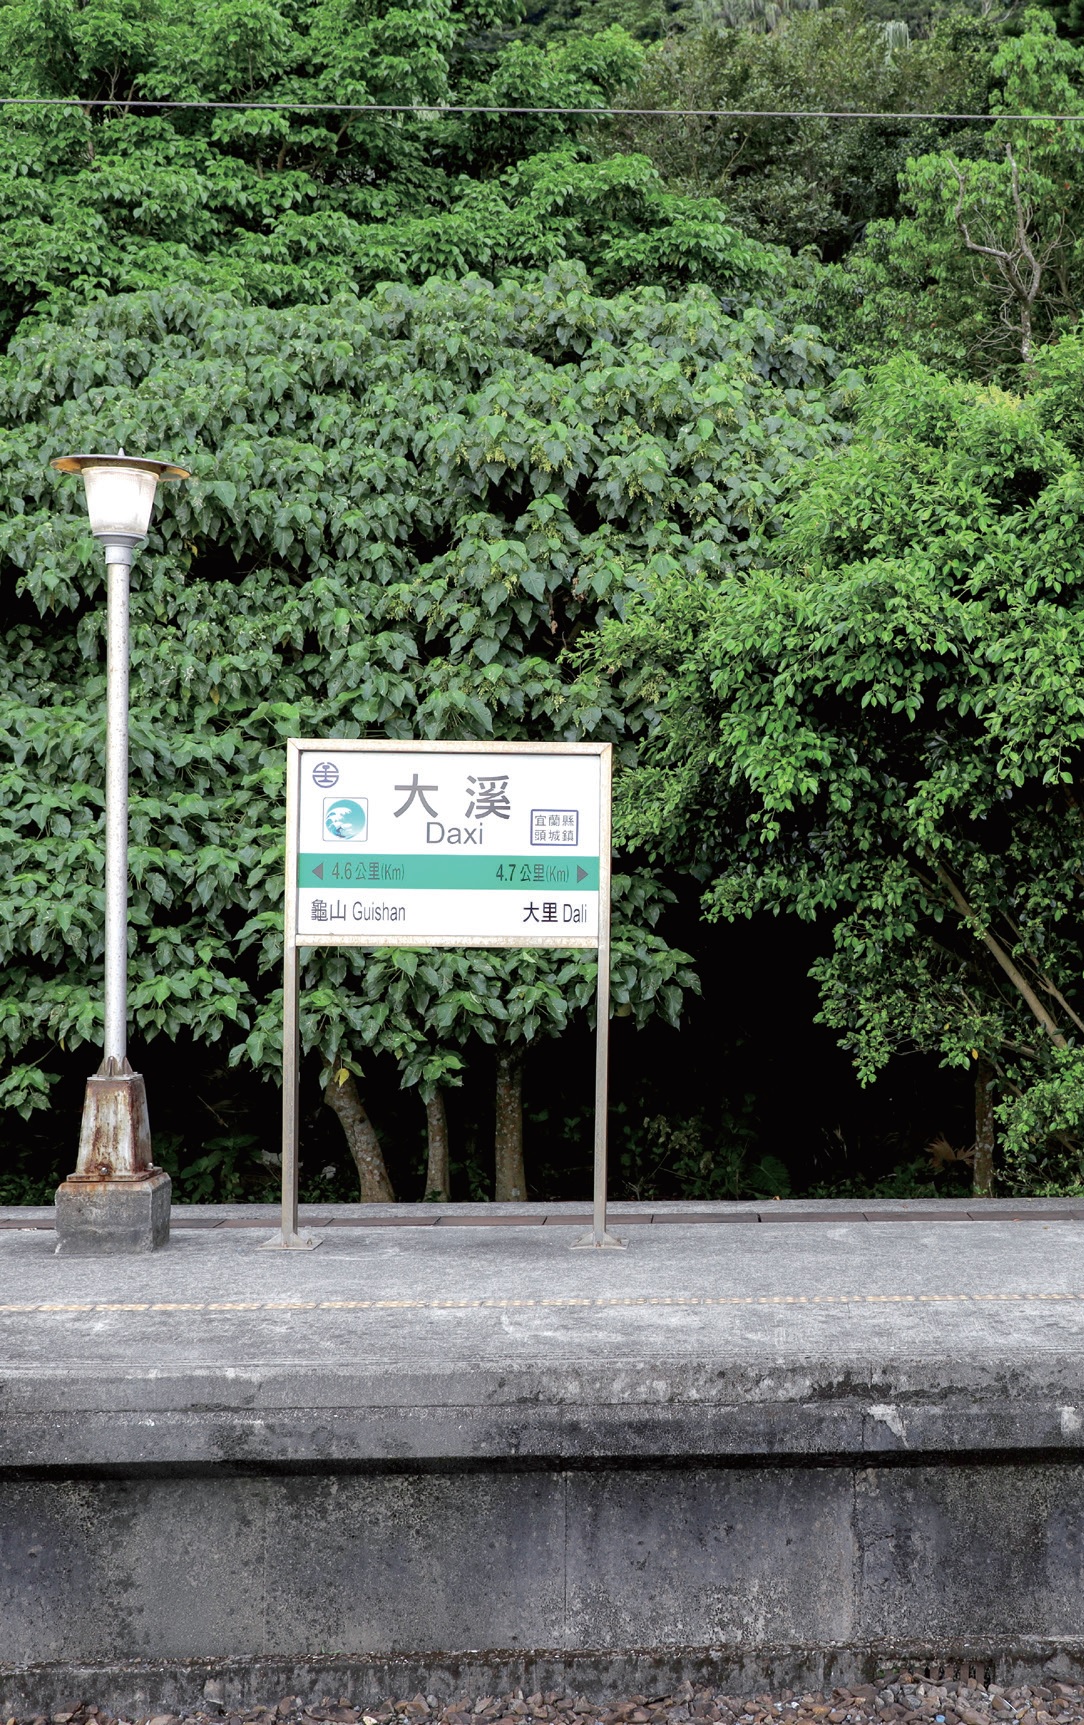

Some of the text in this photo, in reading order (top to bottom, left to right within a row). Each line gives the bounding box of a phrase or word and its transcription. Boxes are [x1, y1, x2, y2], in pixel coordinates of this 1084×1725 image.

[393, 773, 511, 820] 大溪
[535, 814, 575, 827] 宜蘭縣
[426, 821, 484, 845] Daxi
[534, 829, 574, 842] 頭城鎮
[310, 898, 406, 922] 龜山 Guishan
[522, 901, 587, 923] 大里 Dali
